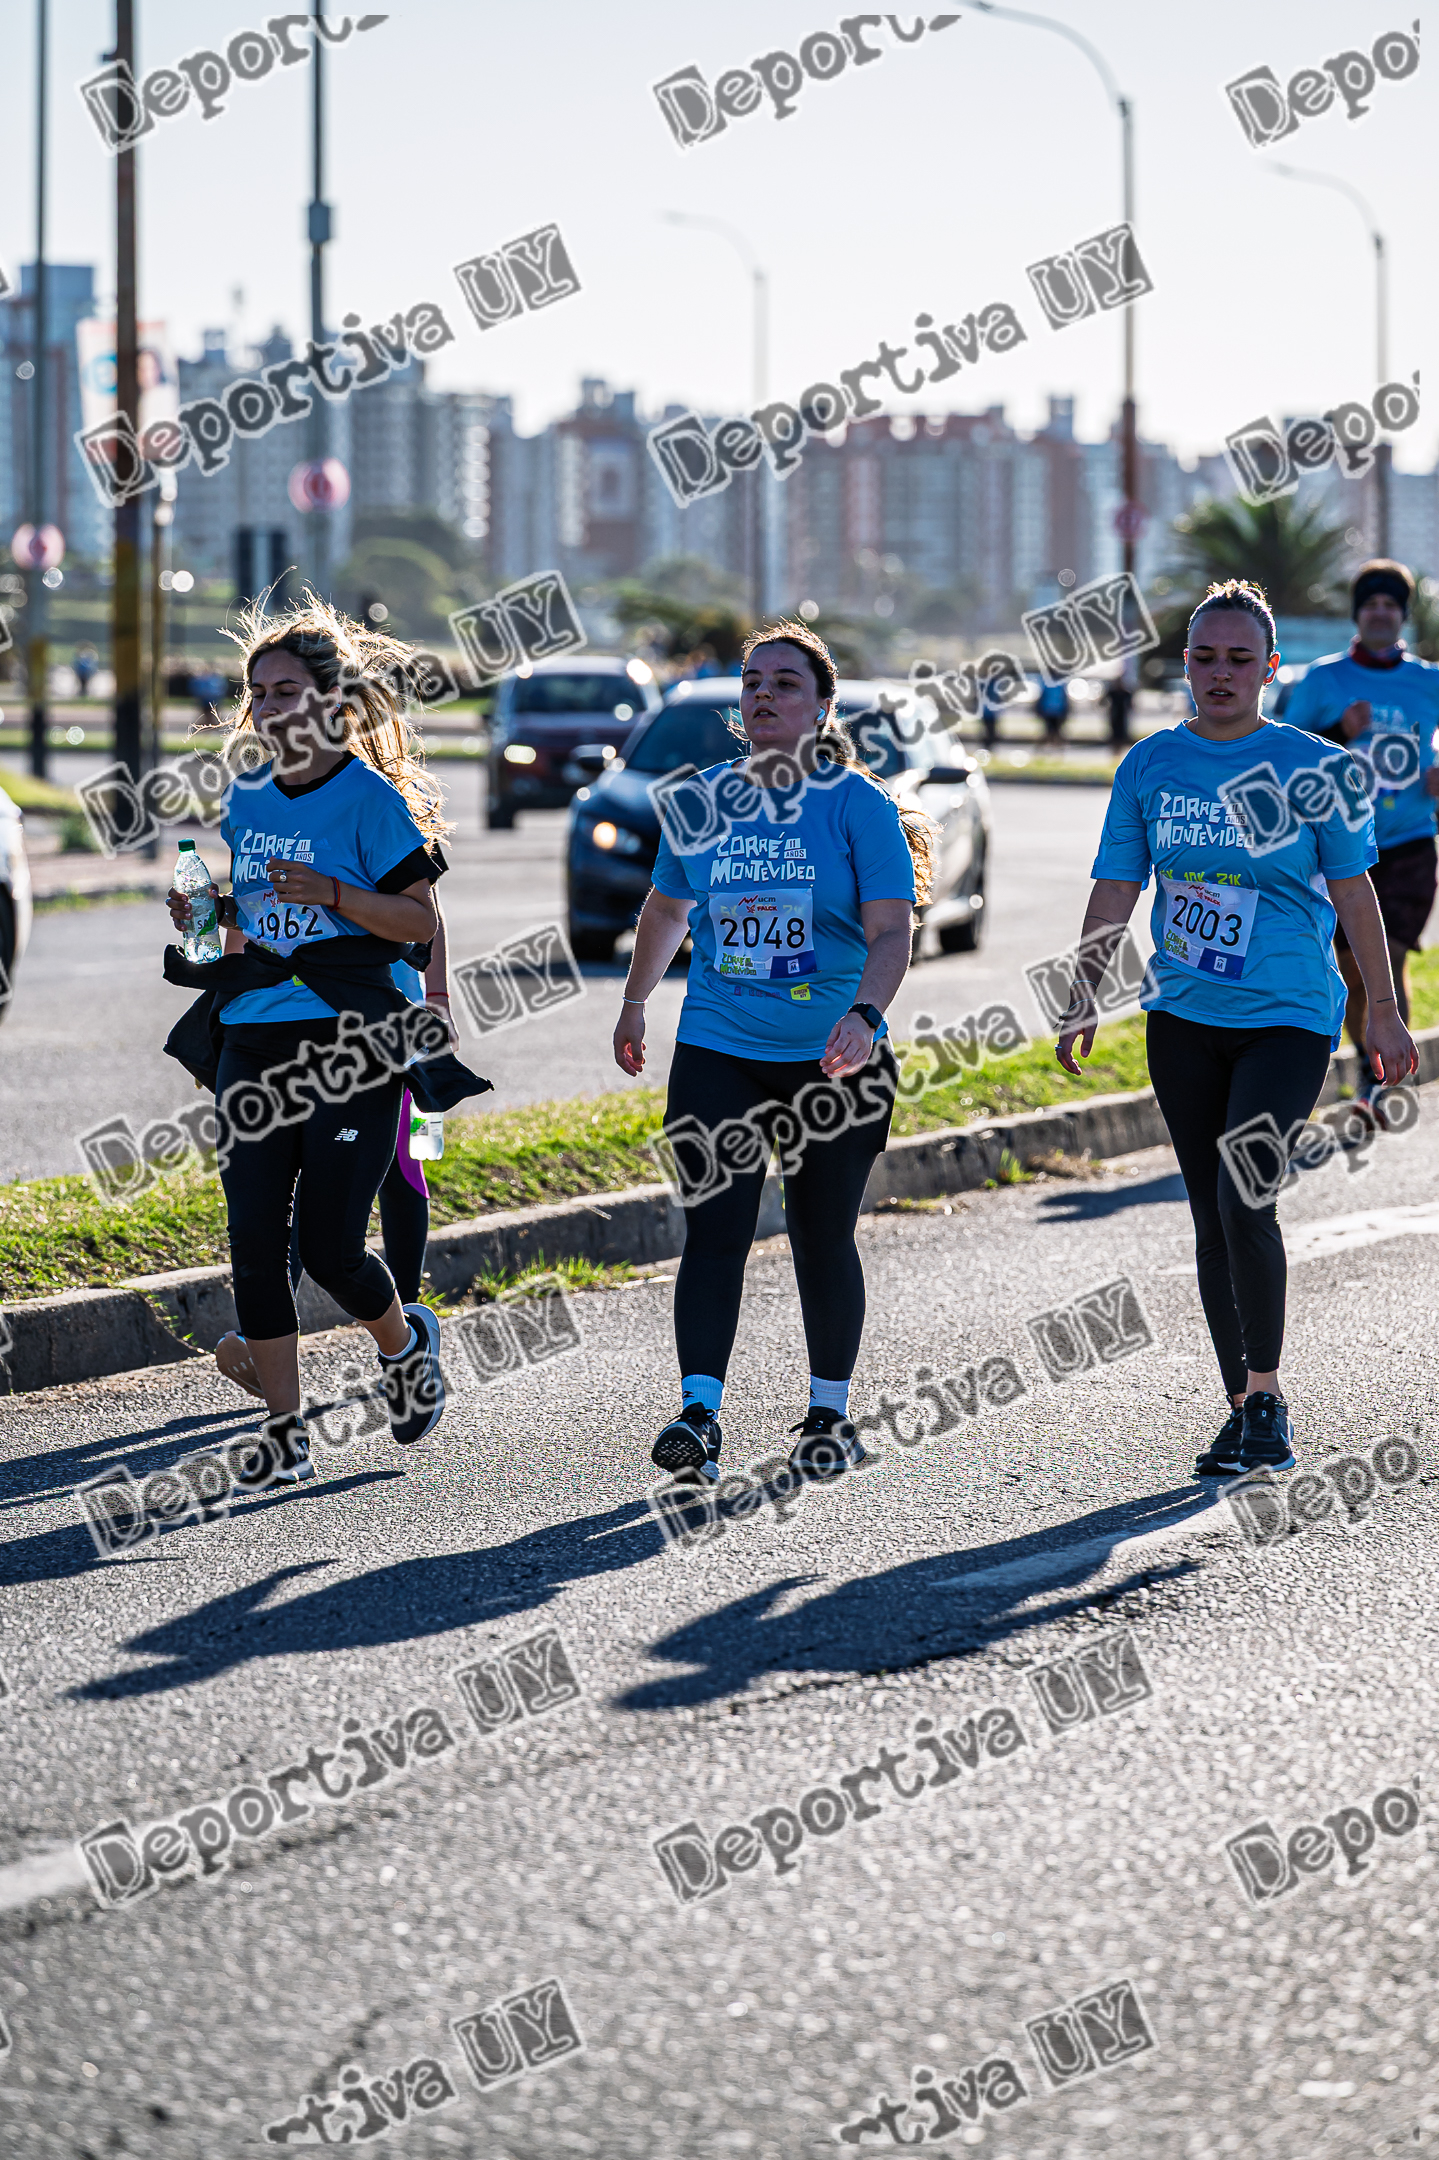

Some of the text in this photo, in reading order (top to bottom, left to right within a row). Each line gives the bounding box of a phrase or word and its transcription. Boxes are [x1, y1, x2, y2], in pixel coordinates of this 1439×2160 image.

[1156, 818, 1255, 849] MONTEVIDEO
[785, 849, 805, 858] AÑOS
[710, 857, 817, 887] MONTEVIDEO
[1216, 873, 1242, 886] 21K
[257, 906, 324, 941] 1962
[719, 916, 806, 949] 2048
[1172, 894, 1242, 947] 2003
